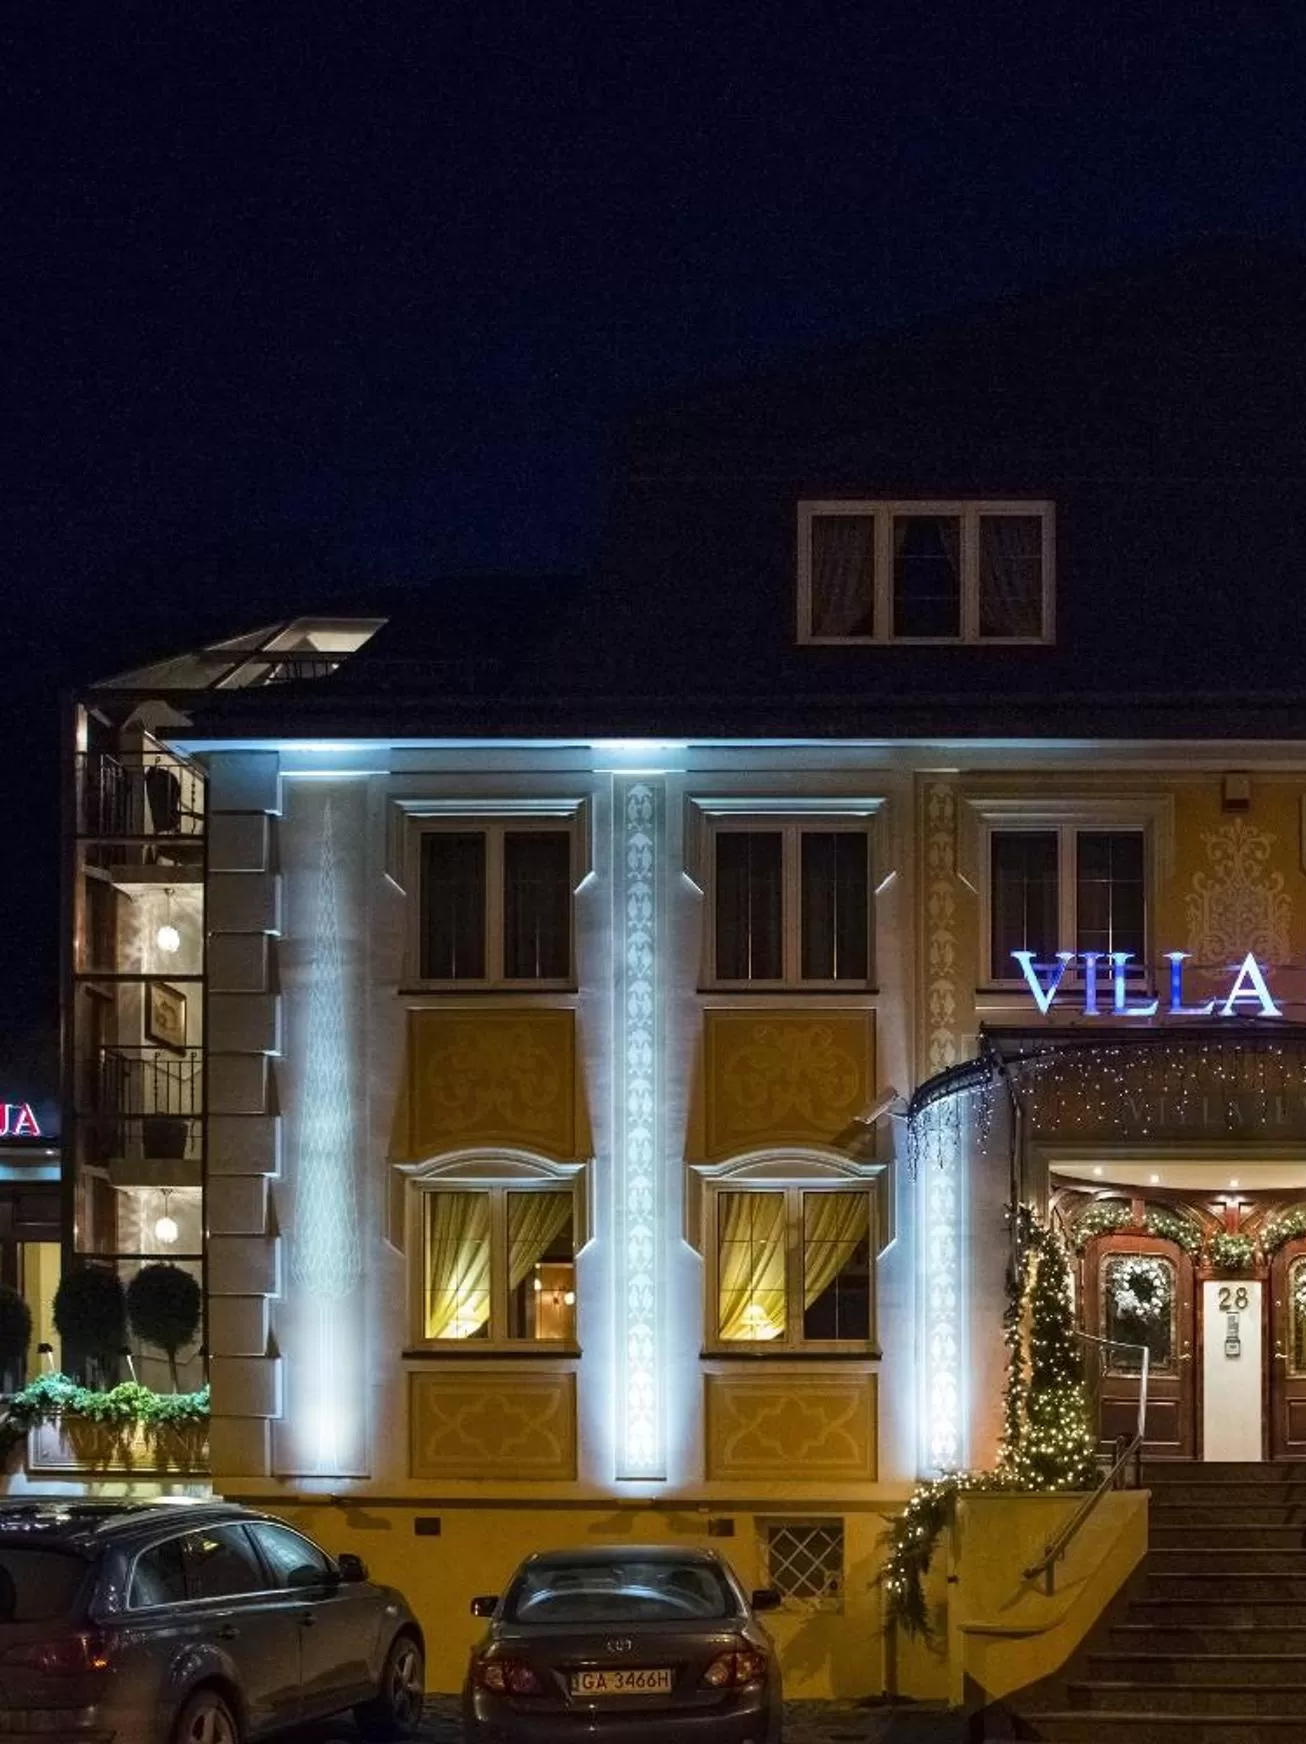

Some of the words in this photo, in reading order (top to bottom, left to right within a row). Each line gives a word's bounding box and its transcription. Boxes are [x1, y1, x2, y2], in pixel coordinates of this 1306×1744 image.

[1011, 950, 1284, 1017] VILLA
[1218, 1287, 1249, 1311] 28
[583, 1673, 607, 1689] GA
[614, 1671, 668, 1689] 3466H
